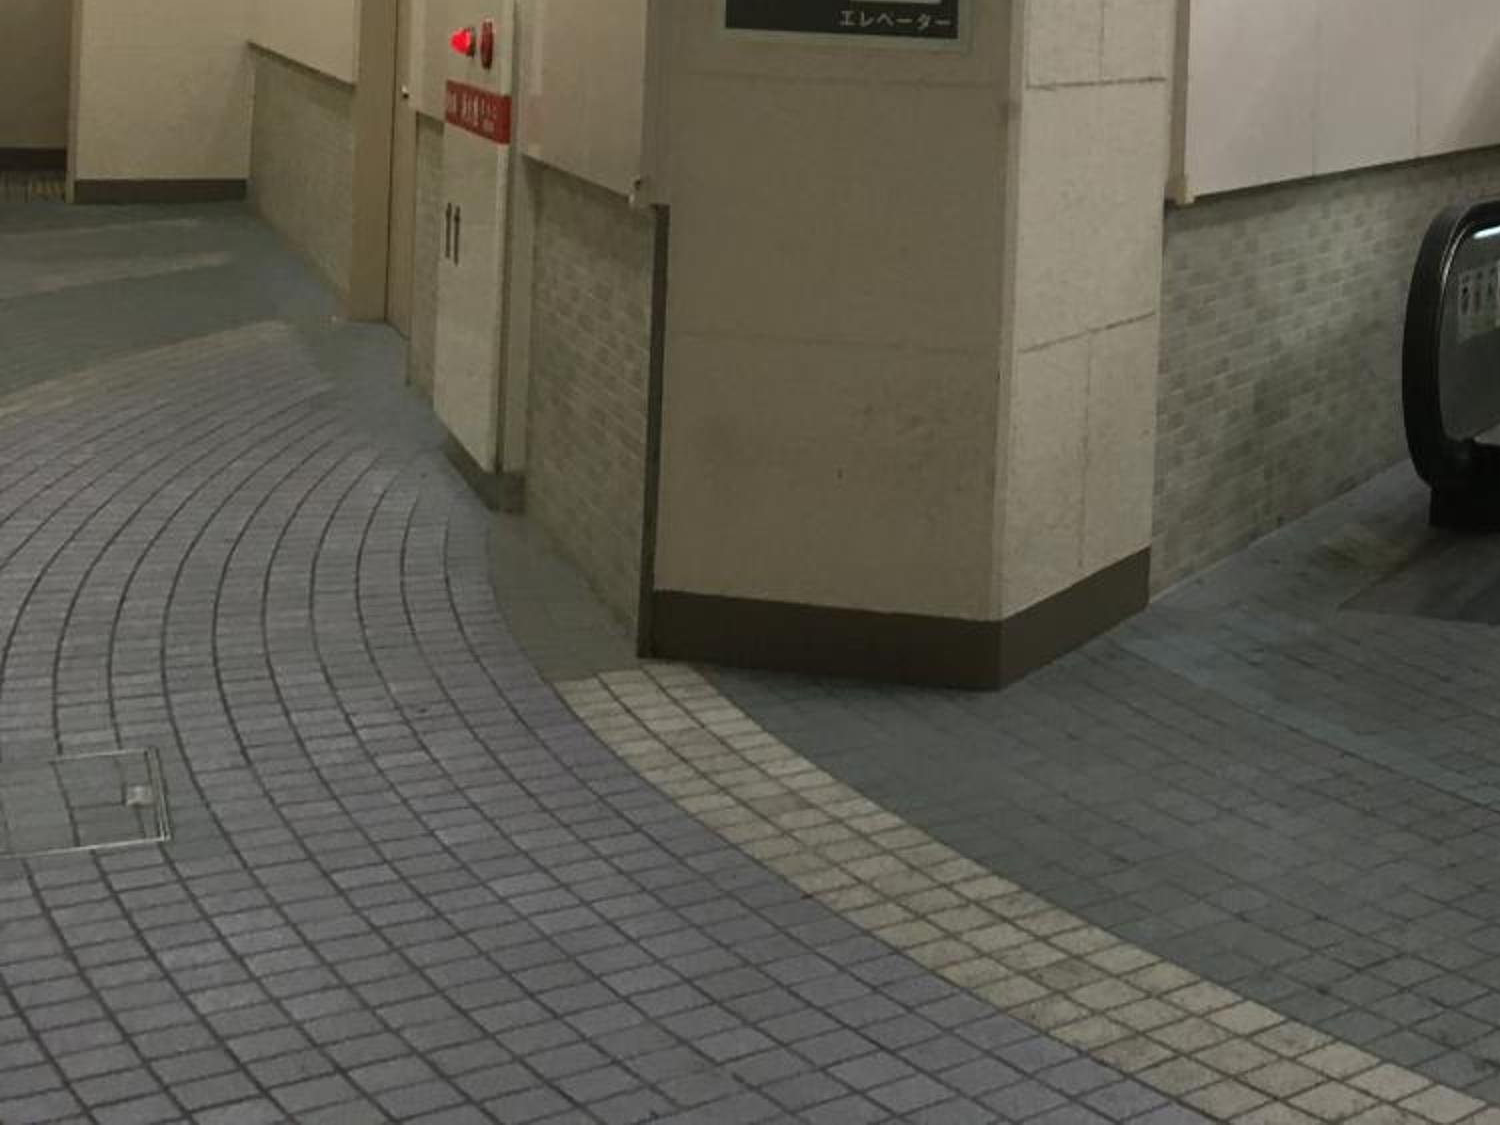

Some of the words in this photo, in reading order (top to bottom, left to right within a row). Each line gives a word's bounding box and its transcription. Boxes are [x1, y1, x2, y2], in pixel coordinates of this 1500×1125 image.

[840, 10, 951, 30] エレベーター
